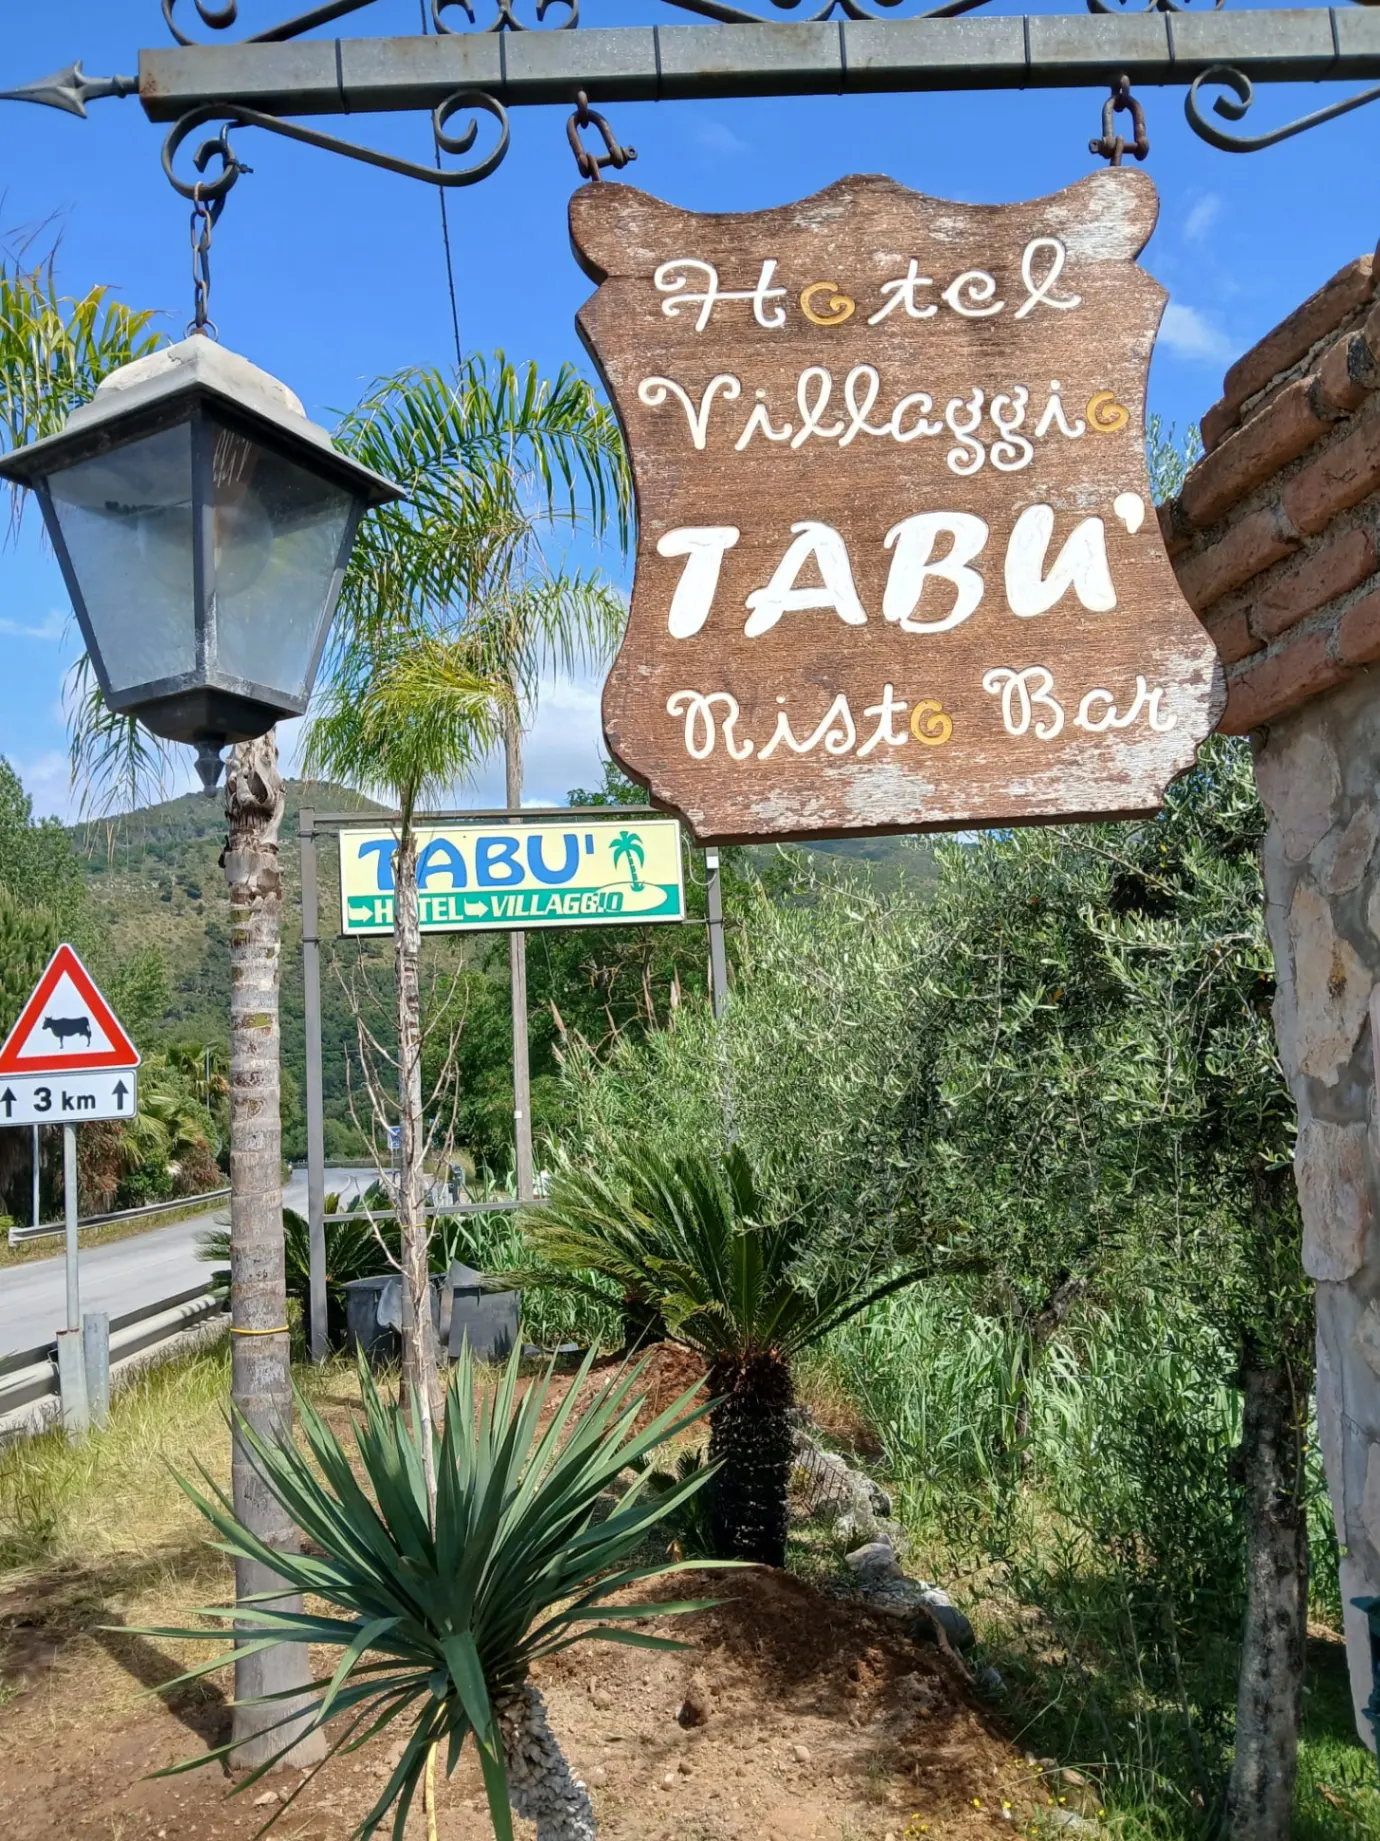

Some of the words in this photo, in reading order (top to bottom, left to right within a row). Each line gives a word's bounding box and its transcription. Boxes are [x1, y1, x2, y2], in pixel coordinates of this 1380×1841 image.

[653, 236, 1082, 332] Hotel
[637, 363, 1130, 475] Villaggio
[656, 491, 1145, 639] TABU'
[666, 683, 954, 761] Risto
[981, 665, 1178, 741] Bar
[358, 834, 594, 891] TABU'
[373, 897, 464, 924] HTEL
[490, 891, 624, 917] VILLAGGIO
[33, 1086, 53, 1112] 3
[61, 1090, 96, 1111] km
